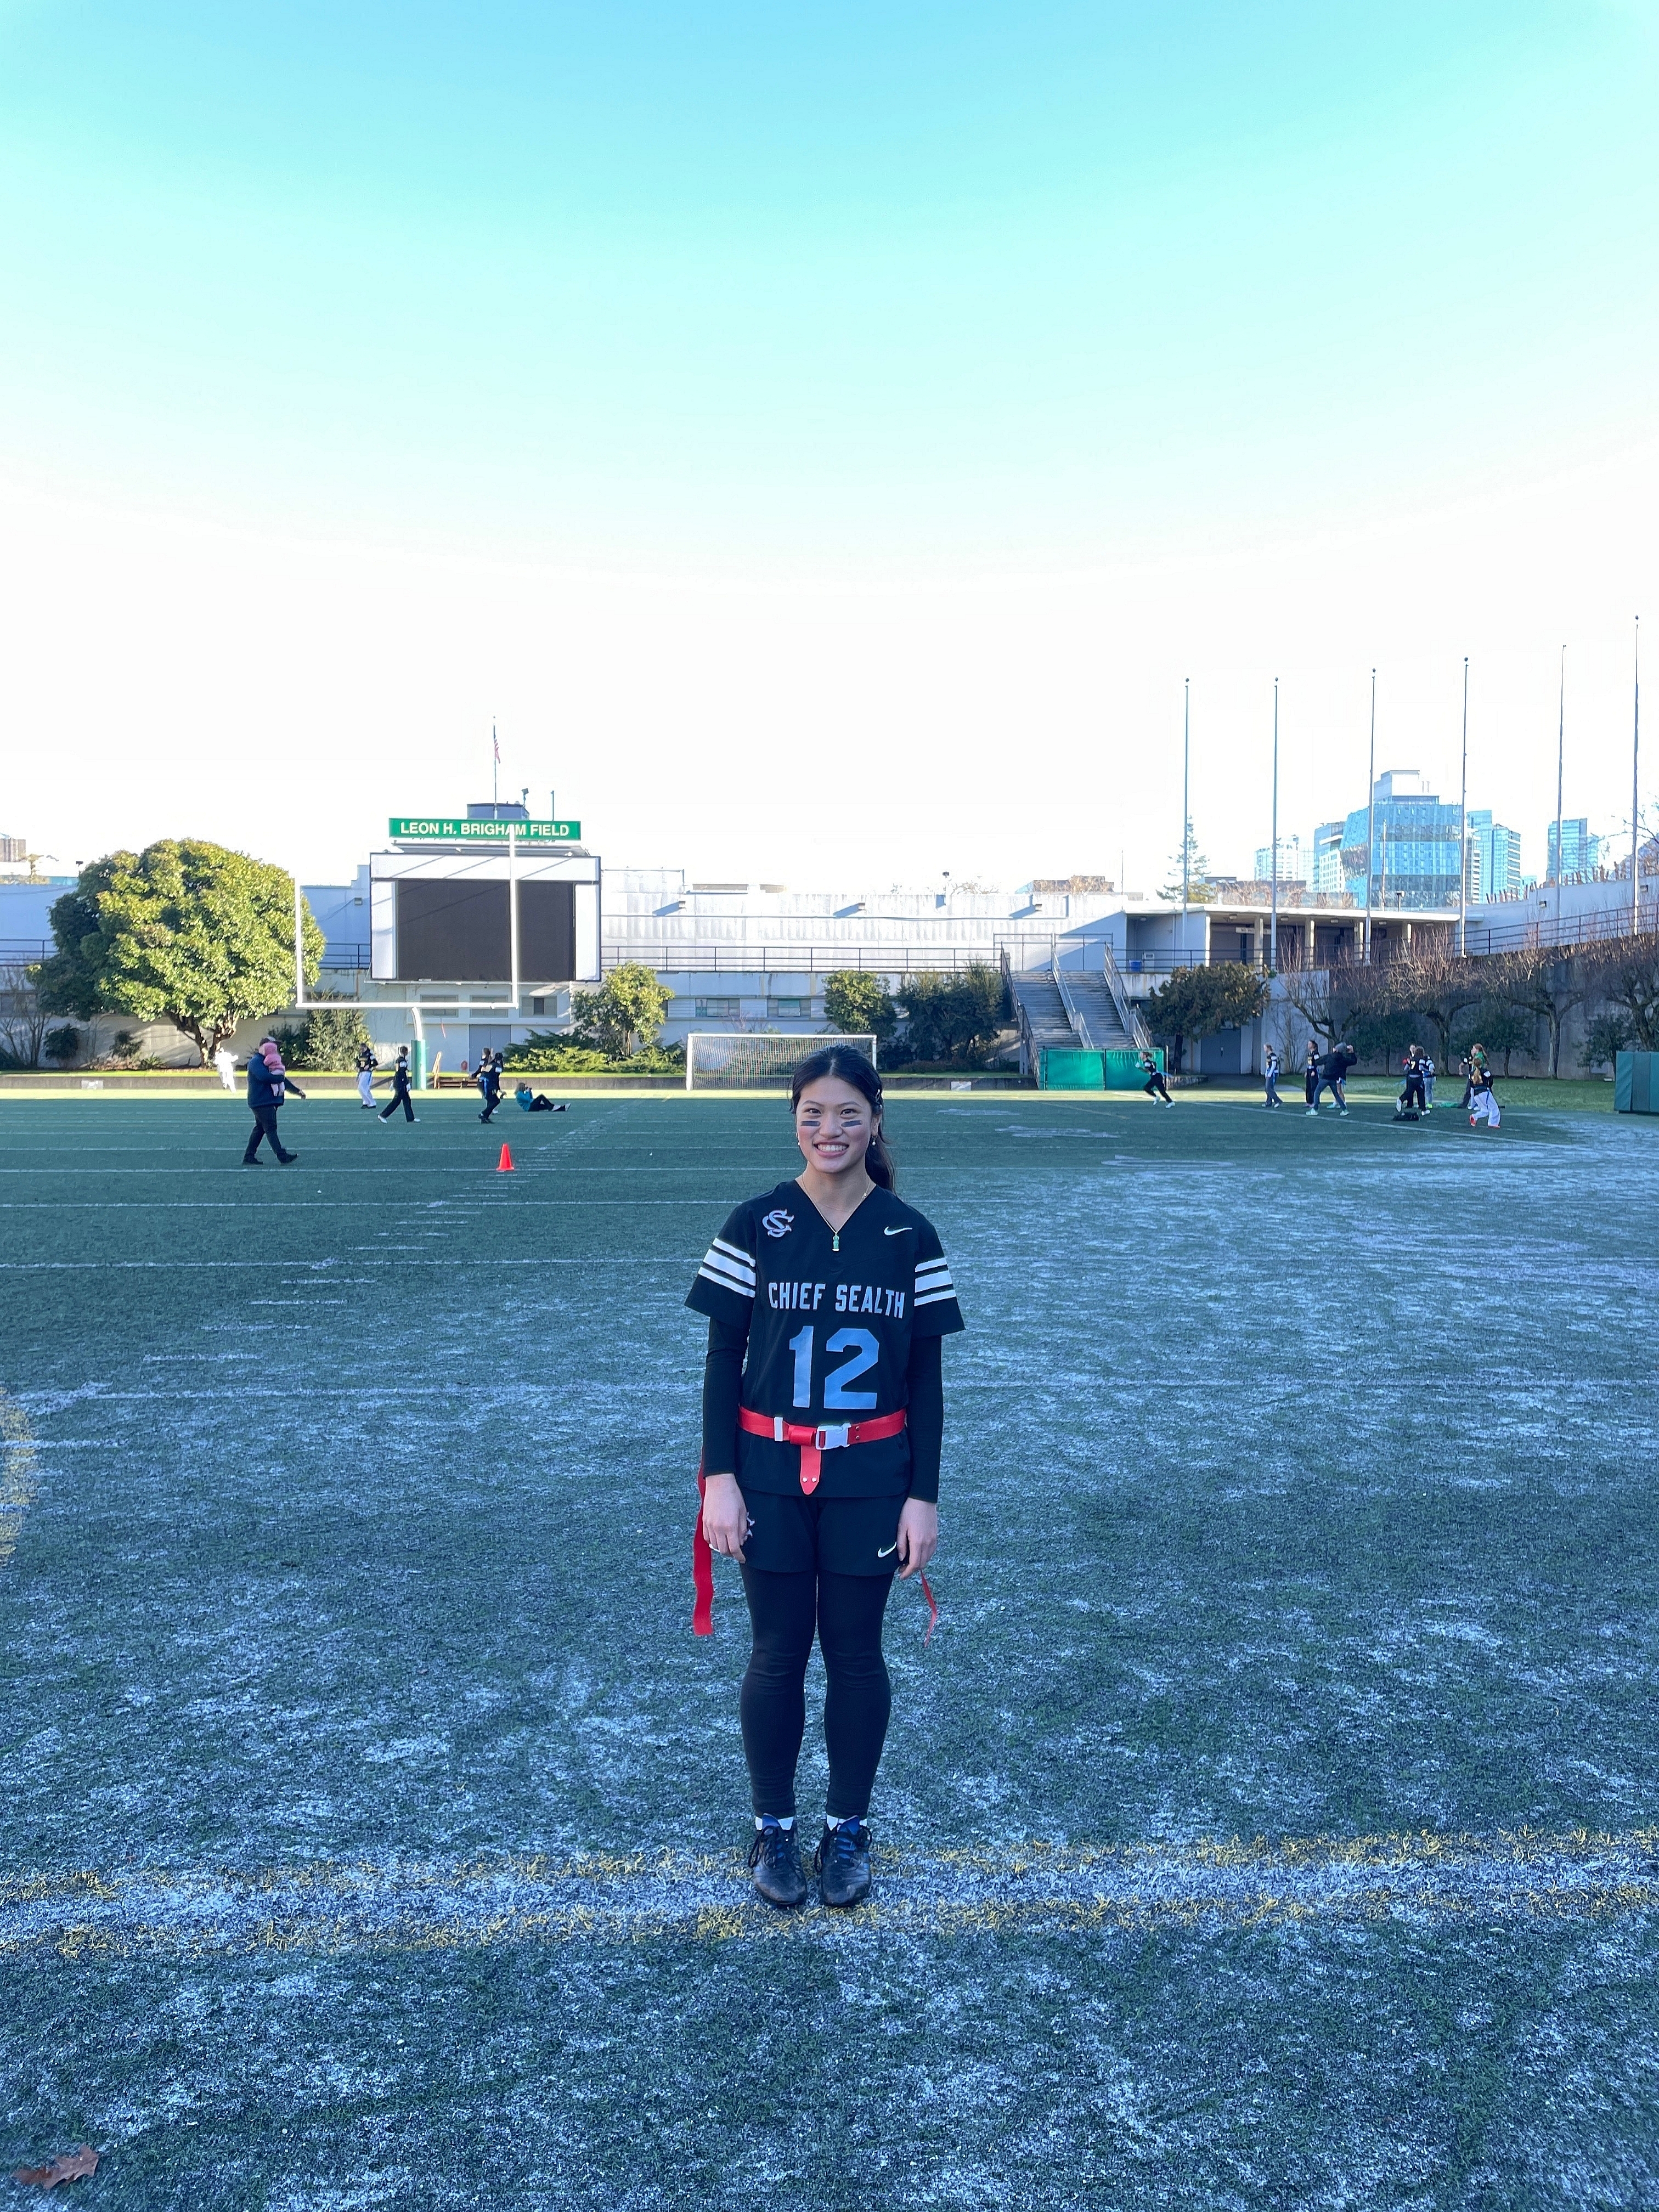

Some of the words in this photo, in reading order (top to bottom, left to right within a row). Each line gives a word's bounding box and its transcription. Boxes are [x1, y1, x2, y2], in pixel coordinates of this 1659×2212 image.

[400, 822, 439, 834] LEON
[443, 823, 456, 834] H.
[460, 823, 526, 836] BRIGHAM
[530, 824, 569, 836] FIELD
[768, 1282, 826, 1310] CHIEF
[835, 1284, 905, 1319] SEALTH
[789, 1325, 879, 1409] 12
